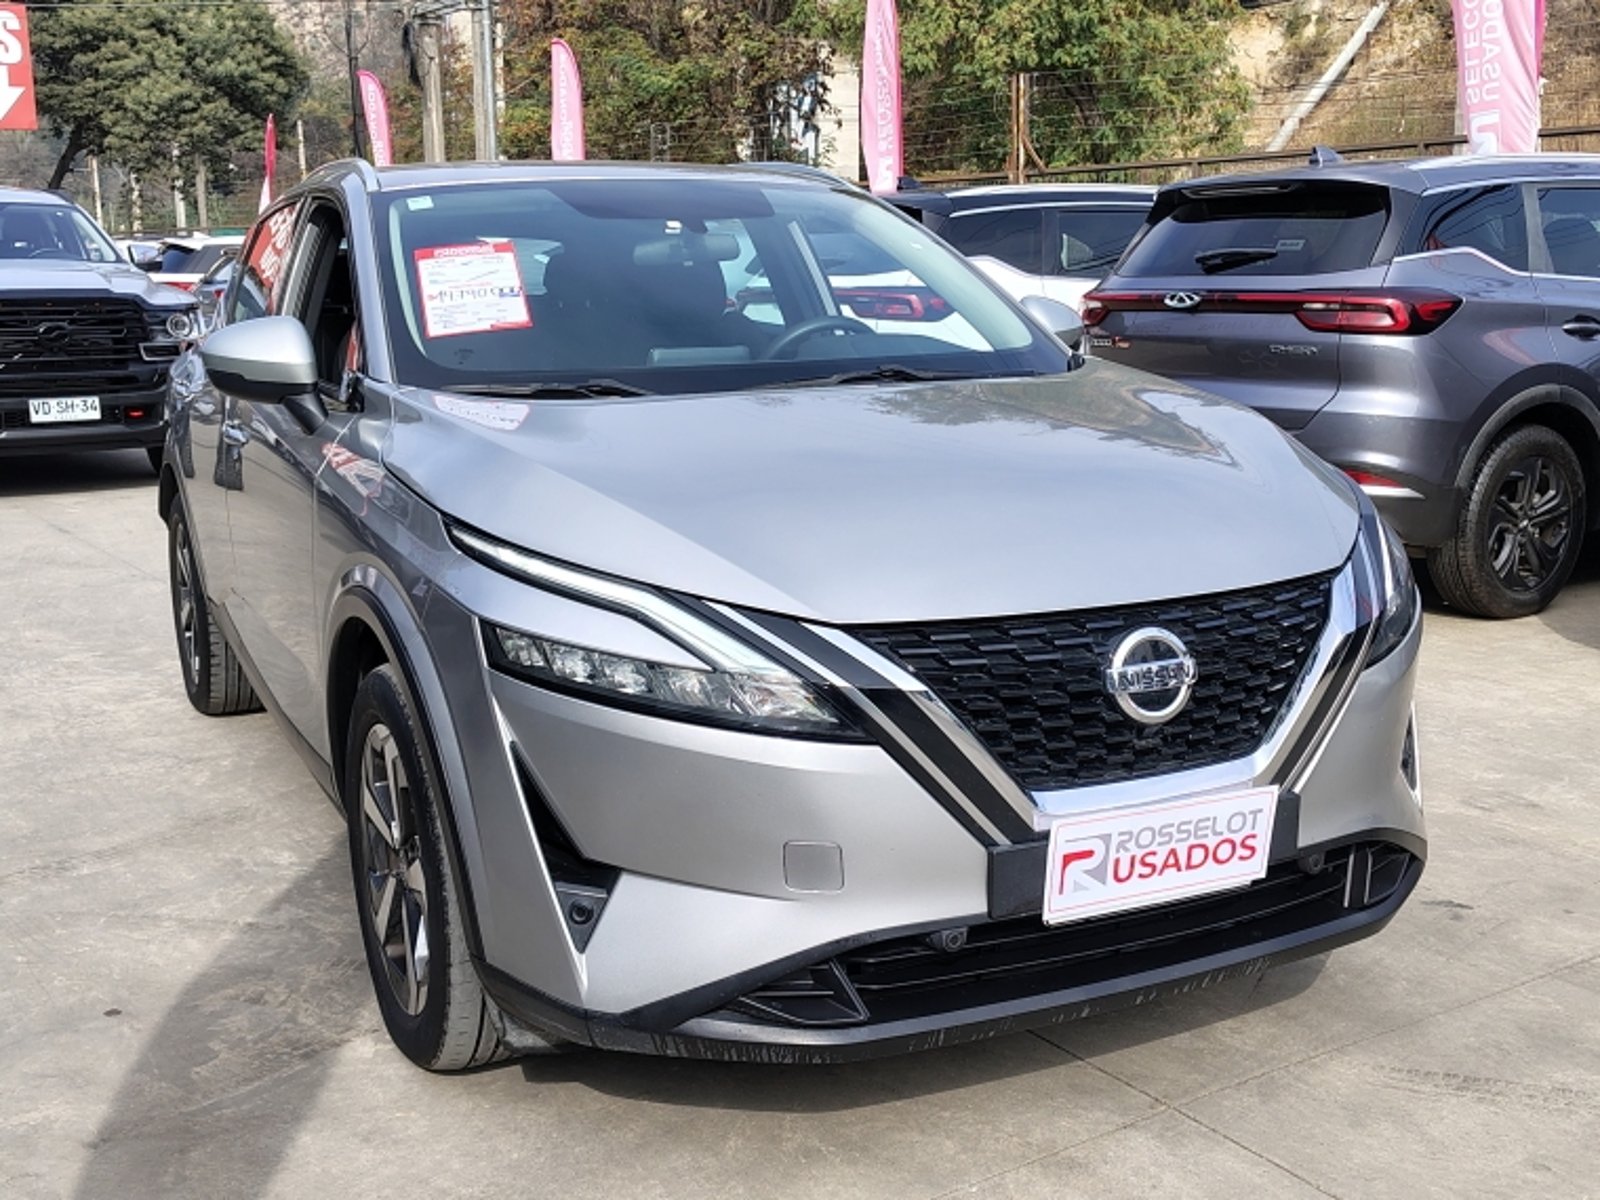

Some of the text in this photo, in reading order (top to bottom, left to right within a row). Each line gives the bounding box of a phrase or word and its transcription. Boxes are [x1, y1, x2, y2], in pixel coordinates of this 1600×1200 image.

[1119, 662, 1191, 692] NISSAN
[1115, 808, 1264, 854] ROSSELOT
[1112, 833, 1258, 884] USADOS
